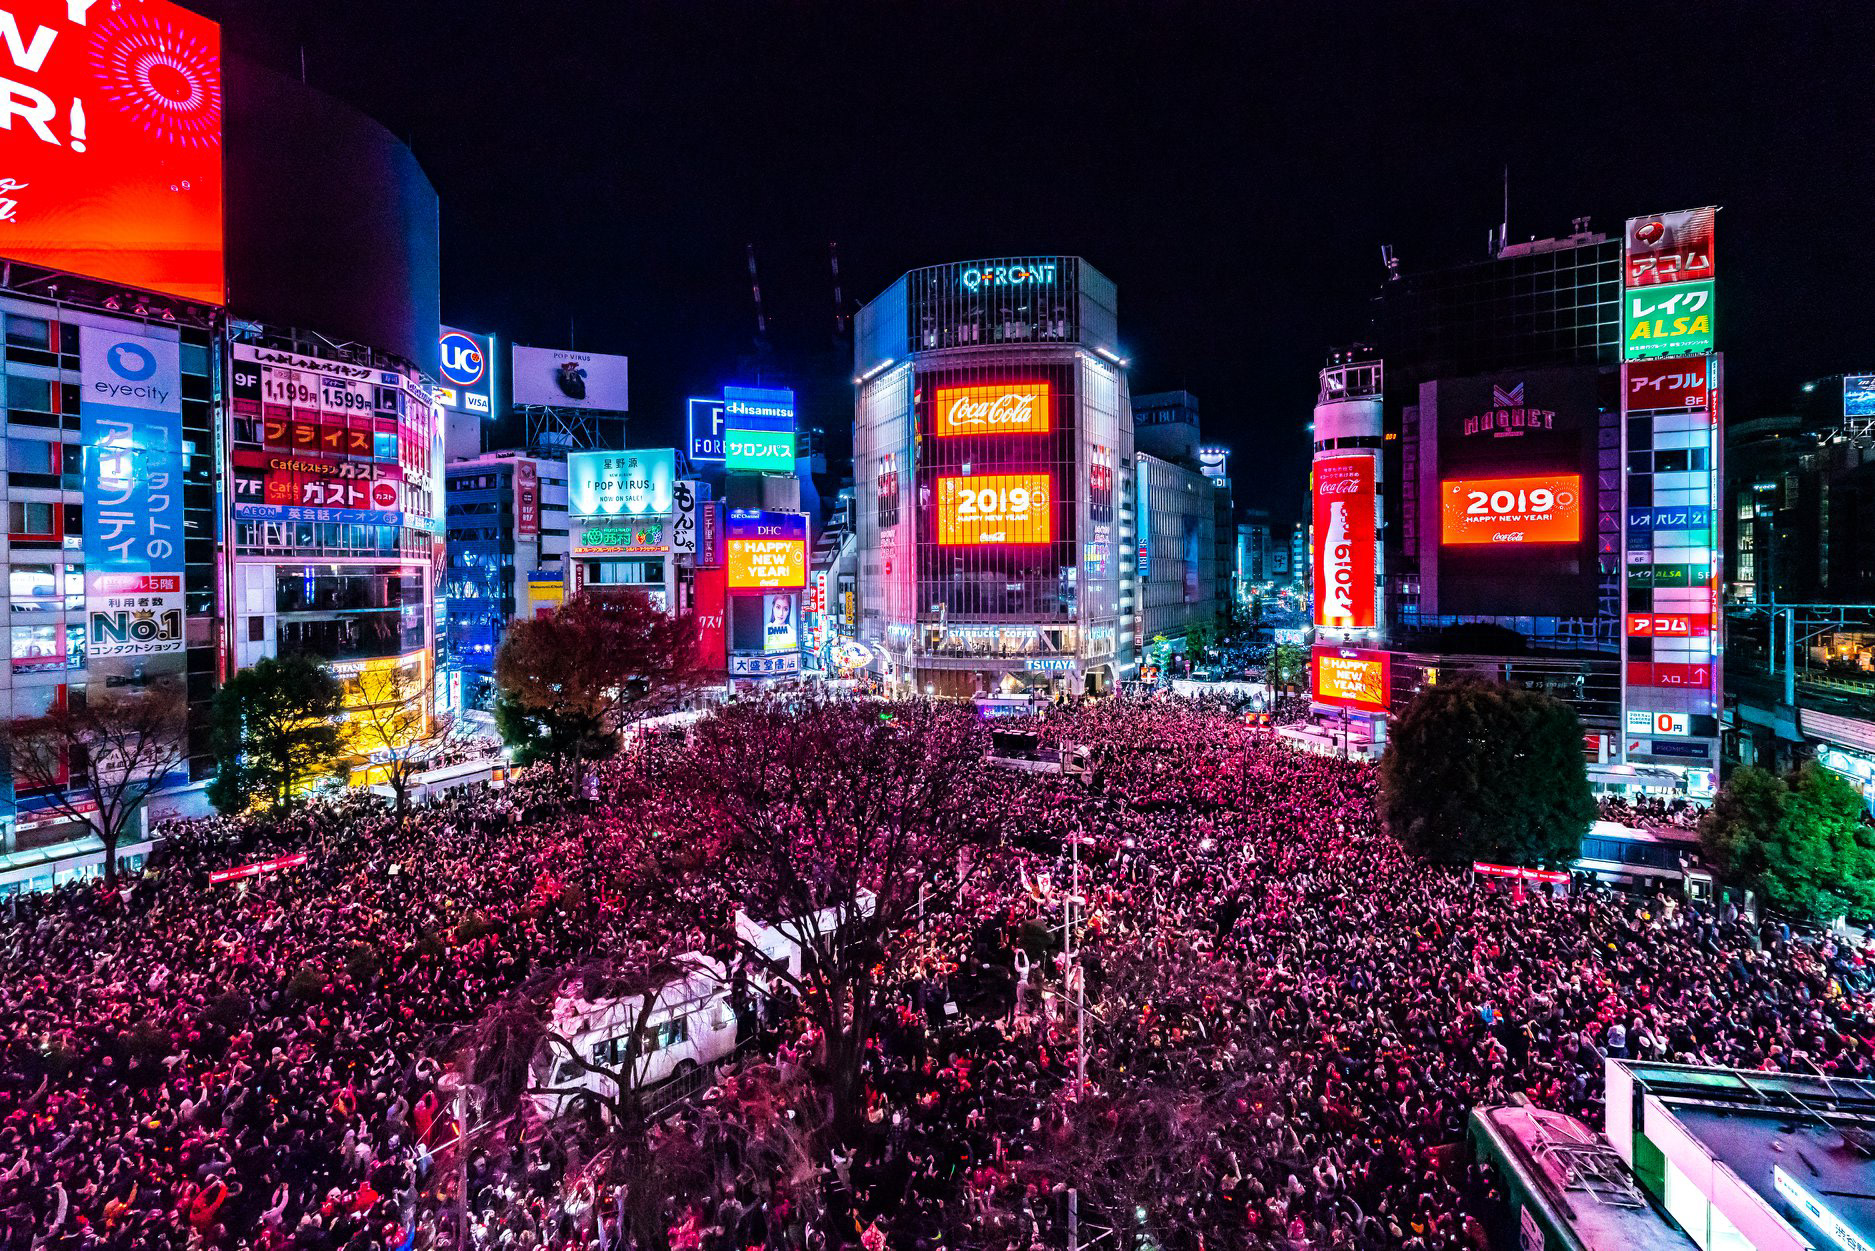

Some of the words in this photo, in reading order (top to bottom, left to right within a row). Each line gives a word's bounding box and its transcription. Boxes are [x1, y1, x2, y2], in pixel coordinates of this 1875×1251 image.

[1632, 252, 1710, 278] アコム
[963, 265, 1056, 292] QFRONT
[1633, 291, 1708, 318] レイク
[1630, 314, 1709, 340] ALSA
[553, 352, 569, 361] POP
[234, 373, 258, 388] 9F
[1631, 373, 1704, 392] アイフル
[95, 381, 169, 404] eyecity
[467, 396, 488, 408] VISA
[1685, 396, 1704, 406] 8F
[726, 402, 794, 418] Hisamitsu
[949, 394, 1037, 426] Coca-Cola
[713, 408, 724, 435] F
[1464, 409, 1556, 436] MAGNET
[266, 422, 368, 449] プライス
[730, 442, 793, 458] サロンパス
[270, 459, 300, 475] Café
[340, 462, 387, 480] ガスト
[603, 458, 638, 470] 星野源
[96, 419, 136, 563] アイシティ
[235, 479, 262, 495] 7F
[269, 481, 299, 494] Café
[303, 481, 365, 506] ガスト
[1320, 479, 1360, 495] Coca-Cola
[375, 493, 394, 501] ガスト
[958, 488, 1030, 514] 2019
[1466, 489, 1554, 514] 2019
[242, 508, 276, 517] AEON
[287, 509, 378, 522] 英会話イーオン
[673, 482, 695, 552] もんじゃ
[1465, 515, 1497, 523] HAPPY
[758, 527, 781, 535] DHC
[1492, 532, 1524, 542] Coca-Cola
[604, 534, 631, 545] 西村
[745, 542, 792, 553] HAPPY
[752, 553, 786, 564] NEW
[747, 566, 789, 577] YEAR!
[109, 597, 163, 607] 利用者数
[90, 609, 182, 645] No.1
[699, 616, 722, 628] クスリ
[1635, 619, 1687, 631] アコム
[768, 626, 788, 634] DMM
[949, 630, 1000, 638] STARBUCKS
[1004, 630, 1038, 638] COFFEE
[90, 642, 182, 656] コンタクトショップ
[1026, 660, 1077, 670] TSUTAYA
[1332, 660, 1369, 672] HAPPY
[1336, 670, 1362, 681] NEW
[1662, 675, 1681, 683] 入口
[1334, 680, 1366, 692] YEAR!
[1658, 714, 1682, 732] 0円
